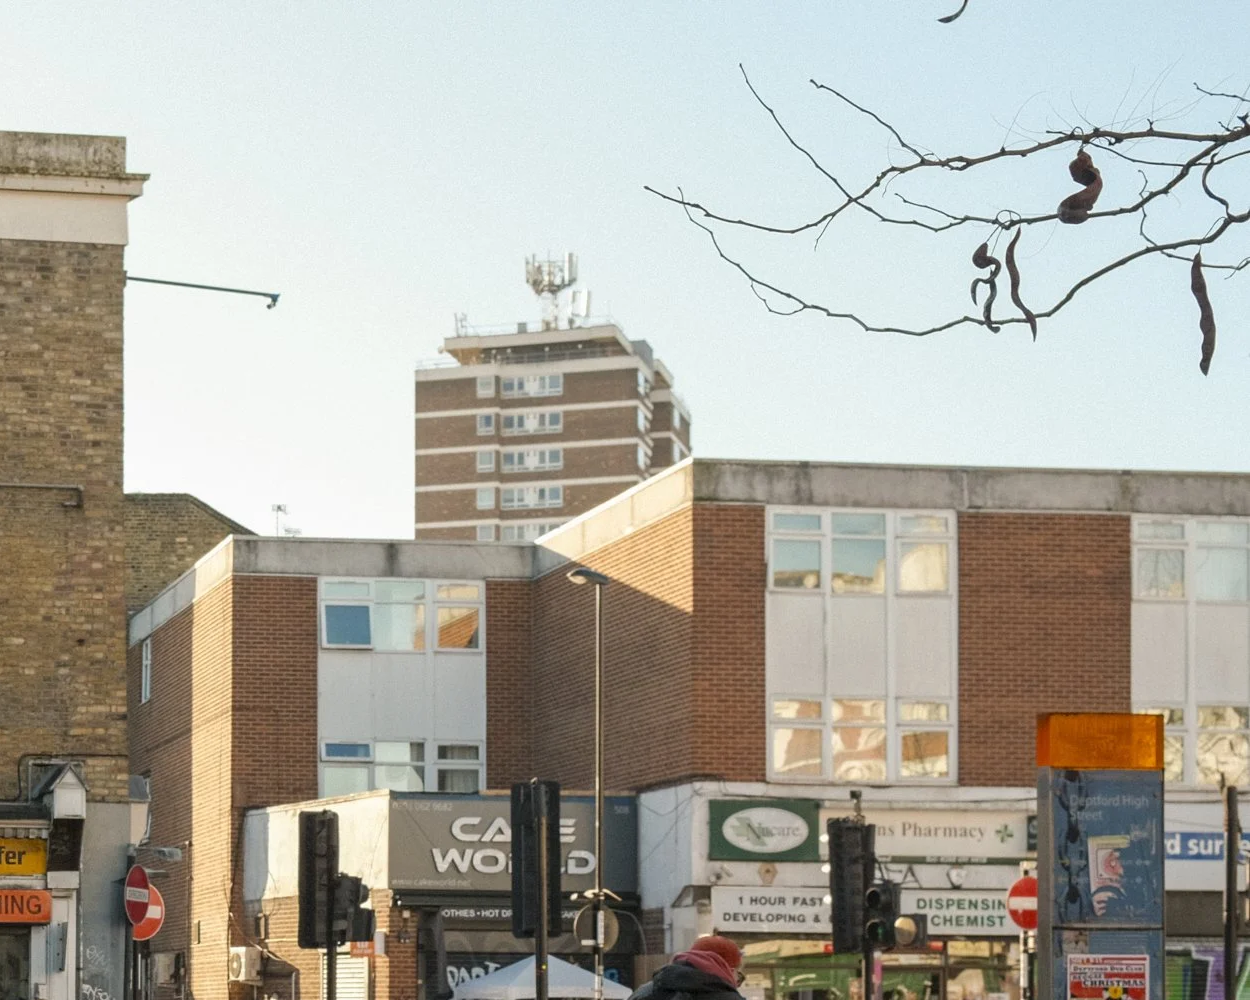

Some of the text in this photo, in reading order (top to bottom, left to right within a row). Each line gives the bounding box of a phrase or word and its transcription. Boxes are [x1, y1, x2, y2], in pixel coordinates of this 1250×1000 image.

[1070, 794, 1149, 809] Deptford High
[1070, 810, 1103, 820] Street
[452, 817, 576, 843] CAE
[902, 821, 987, 843] Pharmacy
[432, 848, 596, 875] WOD
[738, 896, 824, 907] 1 HOUR FAST
[917, 898, 1006, 911] DISPENSIN
[481, 908, 499, 918] HOT
[723, 912, 806, 923] DEVELOPING
[813, 914, 821, 923] &
[931, 914, 1006, 927] CHEMIST
